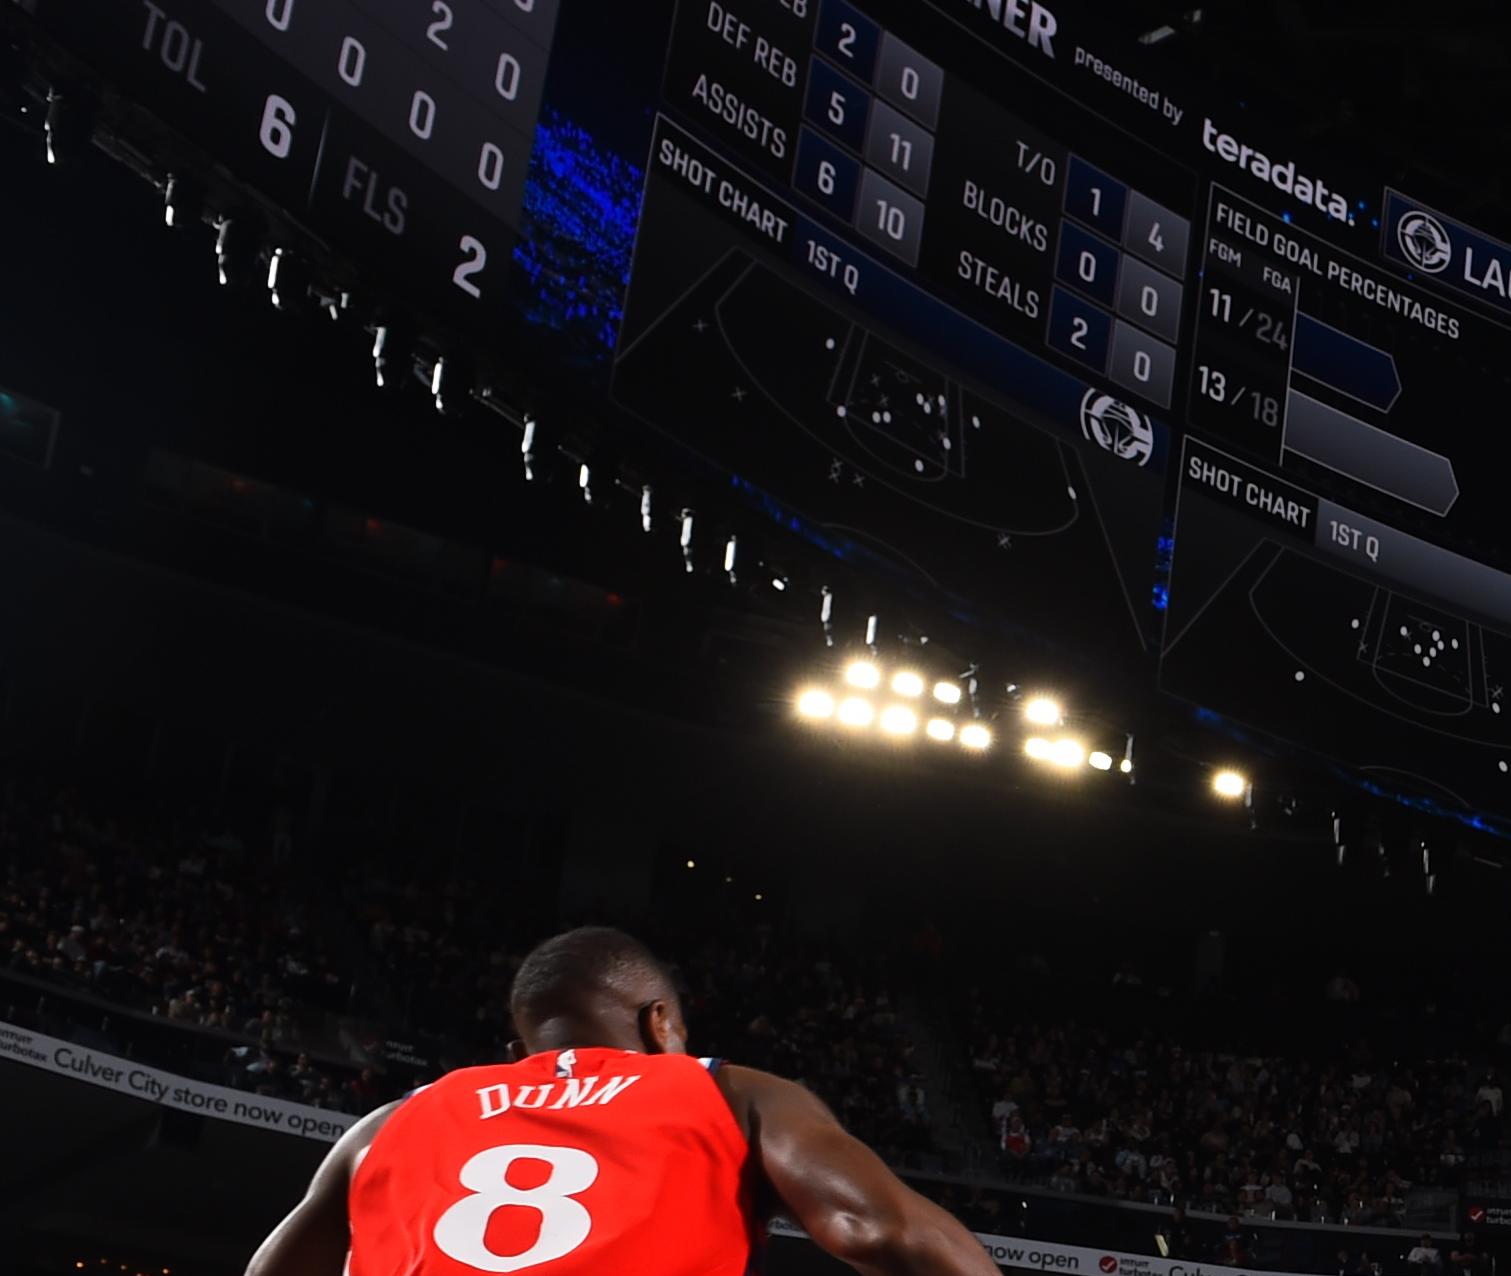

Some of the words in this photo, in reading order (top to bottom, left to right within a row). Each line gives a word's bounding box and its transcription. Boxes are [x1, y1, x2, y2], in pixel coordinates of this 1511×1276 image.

[142, 1, 208, 93] TOL
[259, 94, 297, 159] 6
[426, 0, 454, 51] 2
[495, 52, 521, 101] 0
[706, 1, 751, 49] DEF
[754, 37, 797, 88] REB
[827, 91, 846, 126] 5
[890, 134, 912, 171] 11
[838, 22, 857, 58] 2
[901, 67, 919, 100] 0
[1074, 45, 1159, 112] presented
[1162, 96, 1183, 127] by
[338, 36, 367, 87] 0
[408, 90, 437, 140] 0
[478, 142, 504, 191] 0
[692, 73, 787, 159] ASSISTS
[817, 161, 836, 195] 6
[877, 200, 905, 241] 10
[342, 155, 409, 237] FLS
[451, 235, 487, 299] 2
[659, 138, 717, 194] SHOT
[718, 181, 789, 243] CHART
[807, 240, 842, 278] 1ST
[844, 265, 859, 295] Q
[963, 180, 1047, 253] BLOCKS
[1078, 250, 1096, 283] 0
[1141, 286, 1158, 317] 0
[1016, 140, 1056, 186] T/O
[1090, 188, 1102, 217] 1
[1148, 222, 1164, 253] 4
[958, 250, 1040, 319] STEALS
[1070, 317, 1088, 350] 2
[1134, 351, 1150, 382] 0
[1209, 238, 1242, 268] FGM
[1263, 266, 1291, 294] FGA
[1209, 288, 1232, 323] 11
[1256, 311, 1289, 351] 24
[1216, 202, 1269, 247] FIELD
[1273, 233, 1323, 276] GOAL
[1327, 260, 1461, 340] PERCENTAGES
[1198, 365, 1227, 403] 13
[1251, 391, 1279, 427] 18
[1188, 456, 1243, 498] SHOT
[1245, 483, 1311, 528] CHART
[1330, 520, 1362, 551] 1ST
[1366, 536, 1379, 563] Q
[54, 1047, 123, 1083] Culver
[128, 1069, 169, 1098] City
[172, 1083, 228, 1112] store
[233, 1103, 284, 1125] now
[287, 1112, 345, 1140] open
[476, 1074, 642, 1120] DUNN
[433, 1144, 599, 1273] 8
